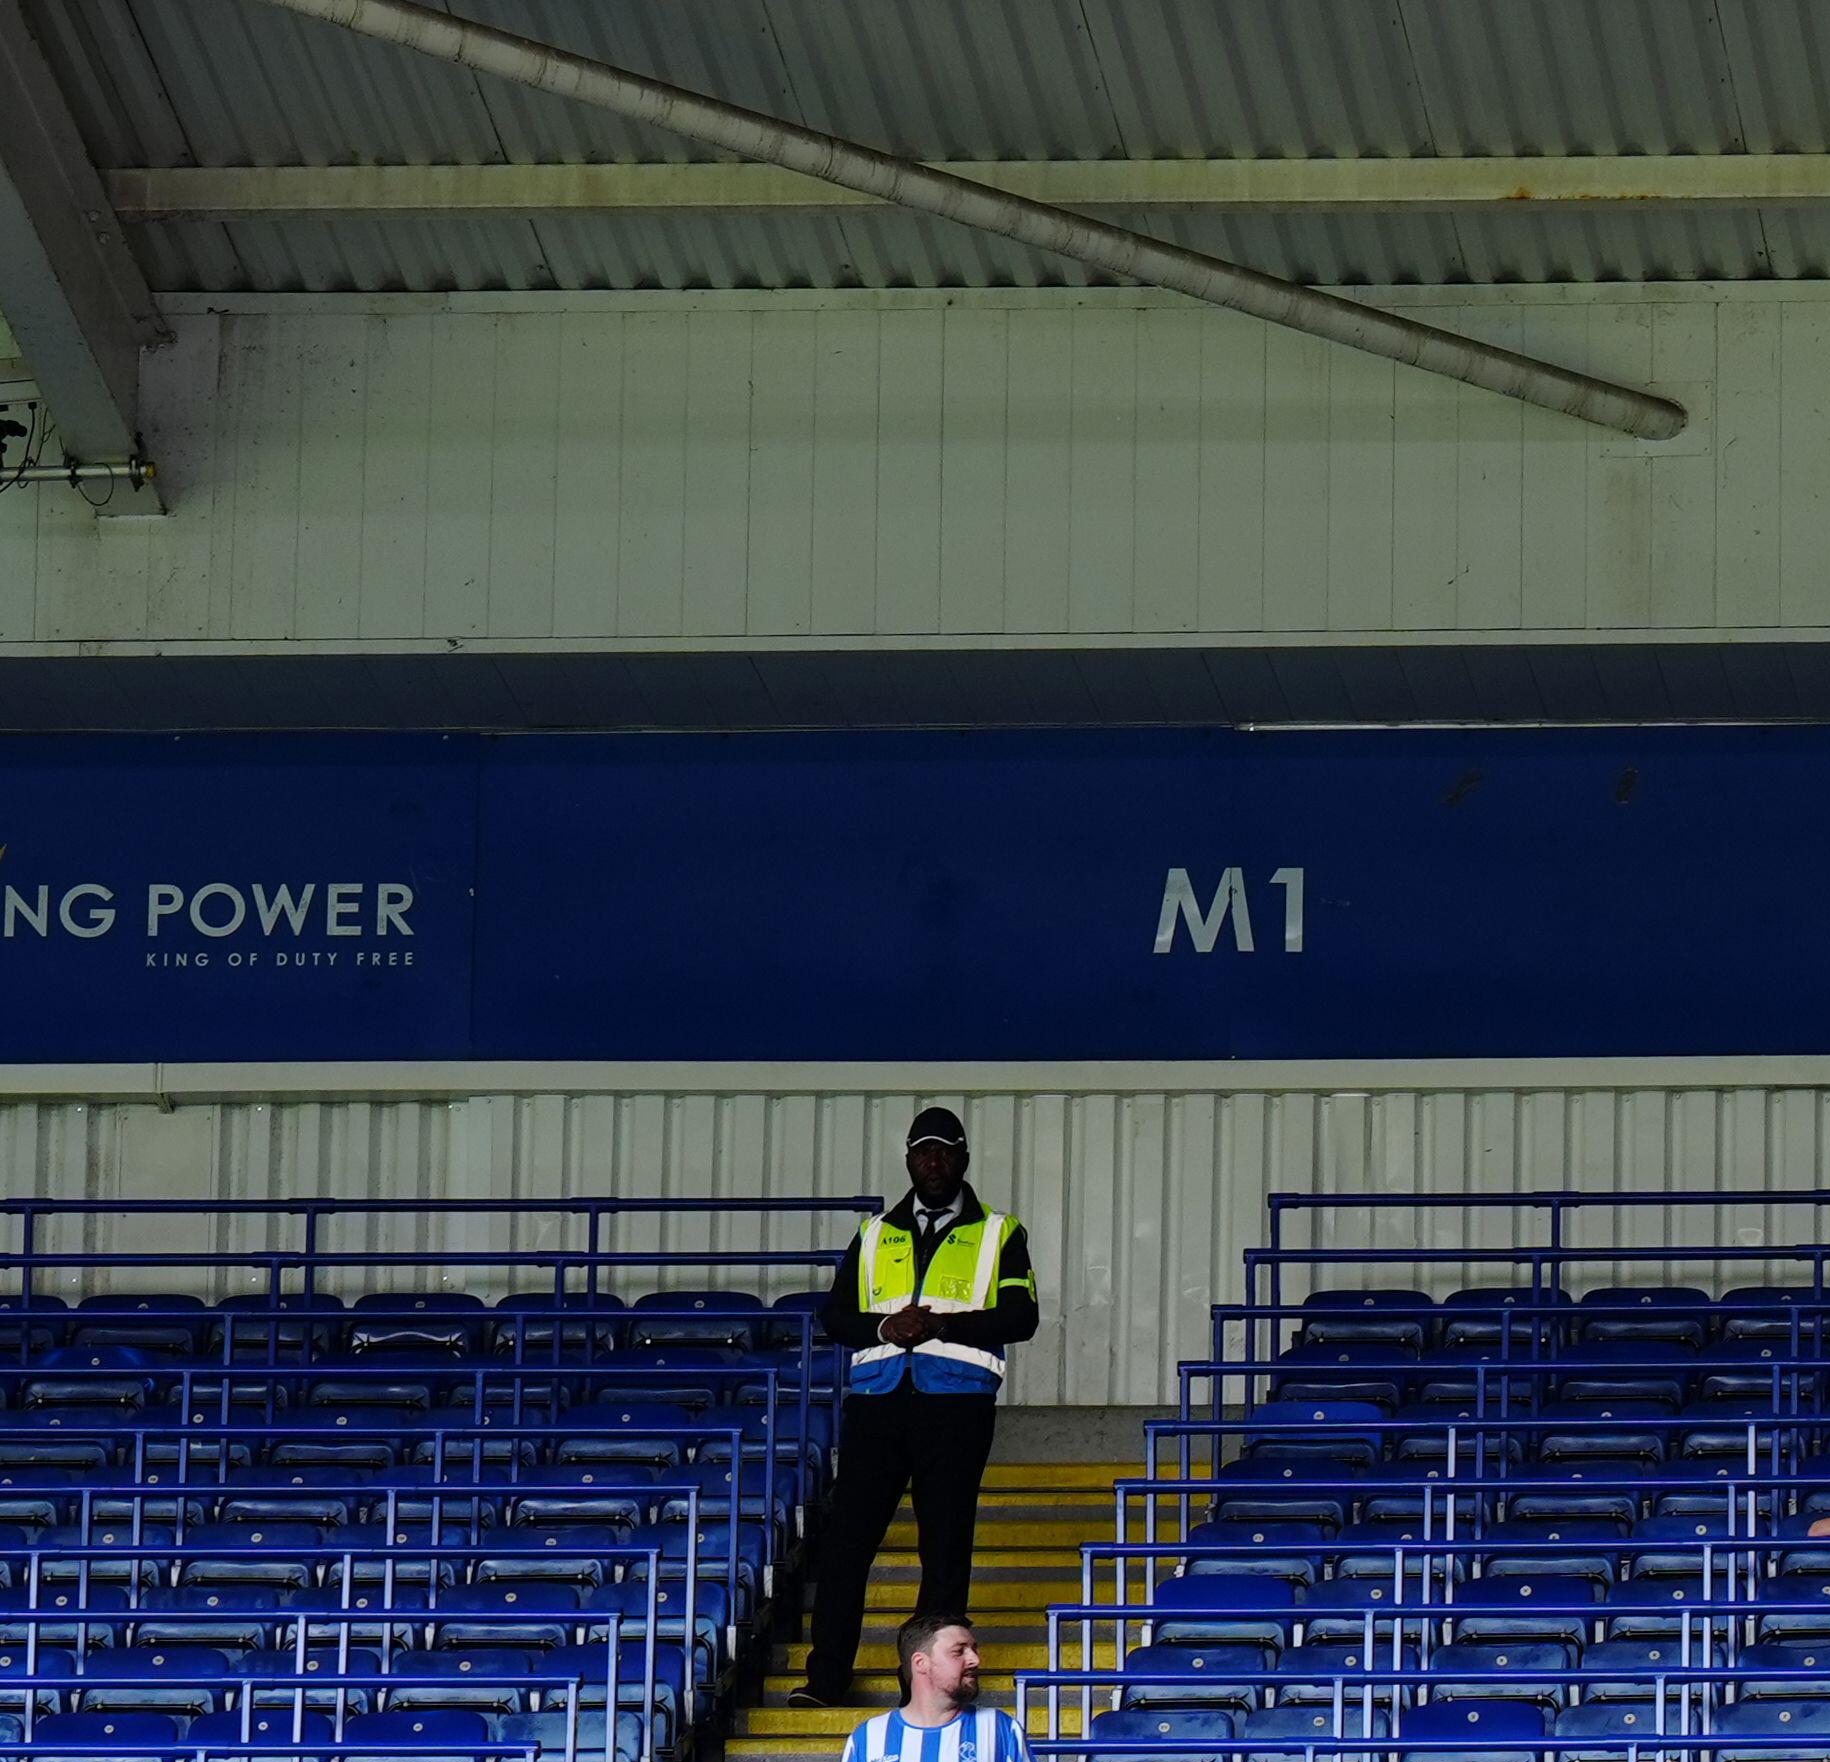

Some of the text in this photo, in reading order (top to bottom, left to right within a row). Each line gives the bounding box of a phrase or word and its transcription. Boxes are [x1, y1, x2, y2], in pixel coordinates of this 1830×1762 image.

[147, 882, 414, 937] POWER
[1153, 867, 1305, 954] M1
[146, 951, 414, 967] KING OF DUTY FREE
